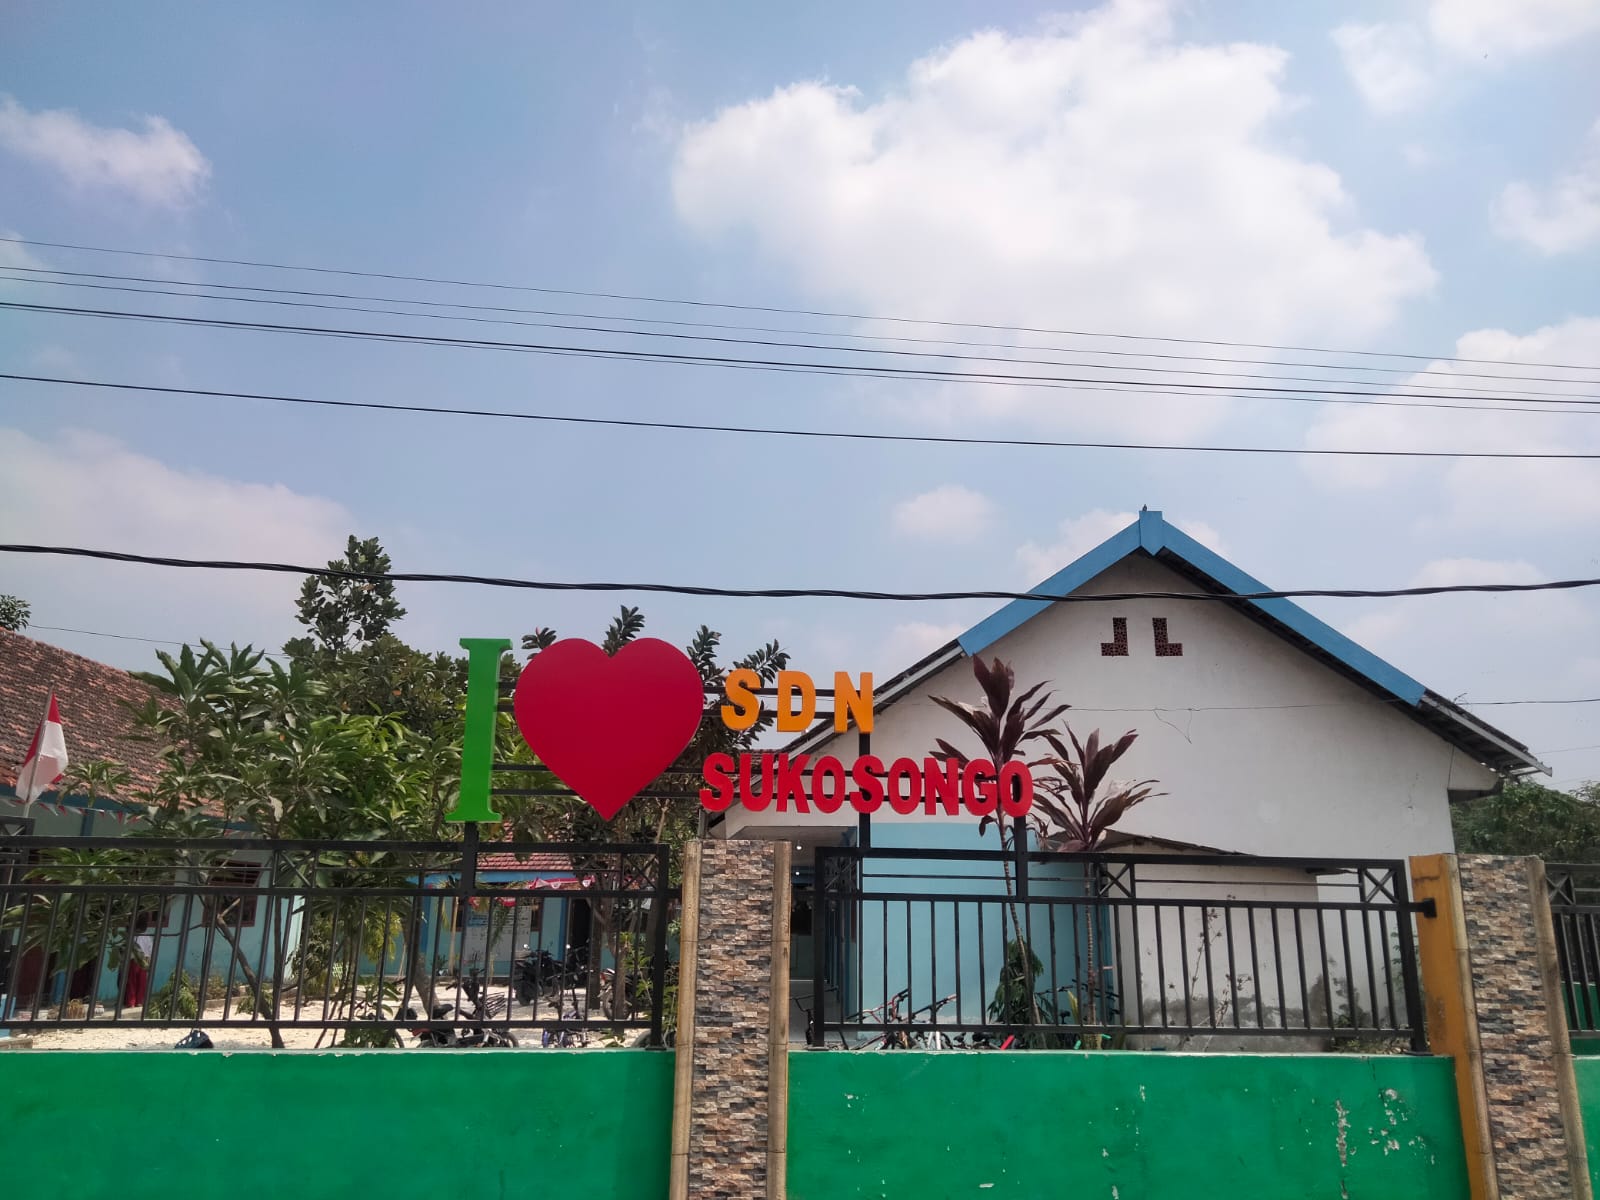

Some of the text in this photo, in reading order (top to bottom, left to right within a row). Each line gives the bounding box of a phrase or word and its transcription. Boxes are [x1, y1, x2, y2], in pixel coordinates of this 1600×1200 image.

[447, 638, 512, 822] I
[721, 669, 873, 733] SDN
[700, 753, 1034, 817] SUKOSONGO
